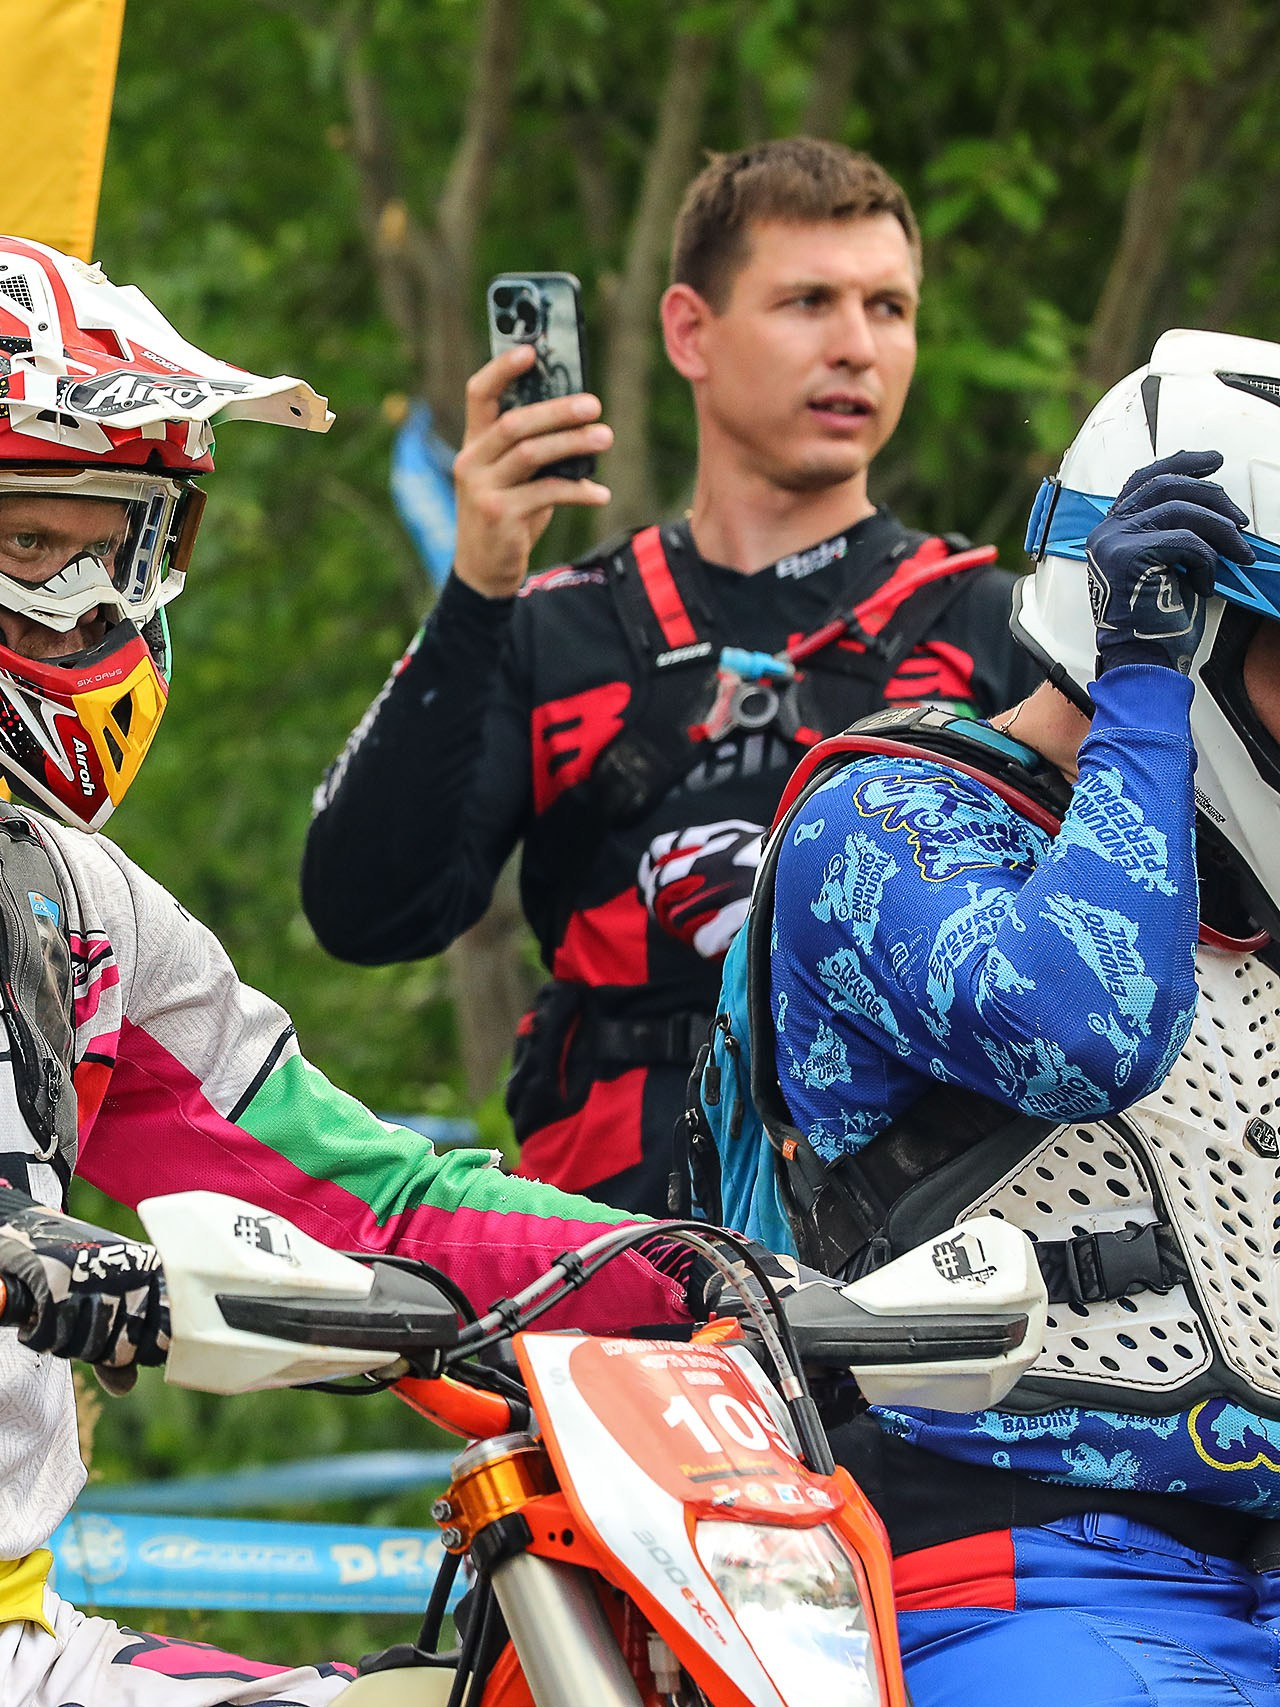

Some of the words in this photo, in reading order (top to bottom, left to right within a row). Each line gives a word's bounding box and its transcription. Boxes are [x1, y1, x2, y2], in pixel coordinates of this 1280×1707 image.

[77, 677, 93, 687] SIX
[95, 668, 123, 682] DAYS
[72, 736, 96, 796] Airoh
[1073, 794, 1143, 871] ENDURO
[852, 852, 877, 922] ENDURO
[1085, 912, 1128, 998] ENDURO
[1002, 1416, 1072, 1433] BABUIN
